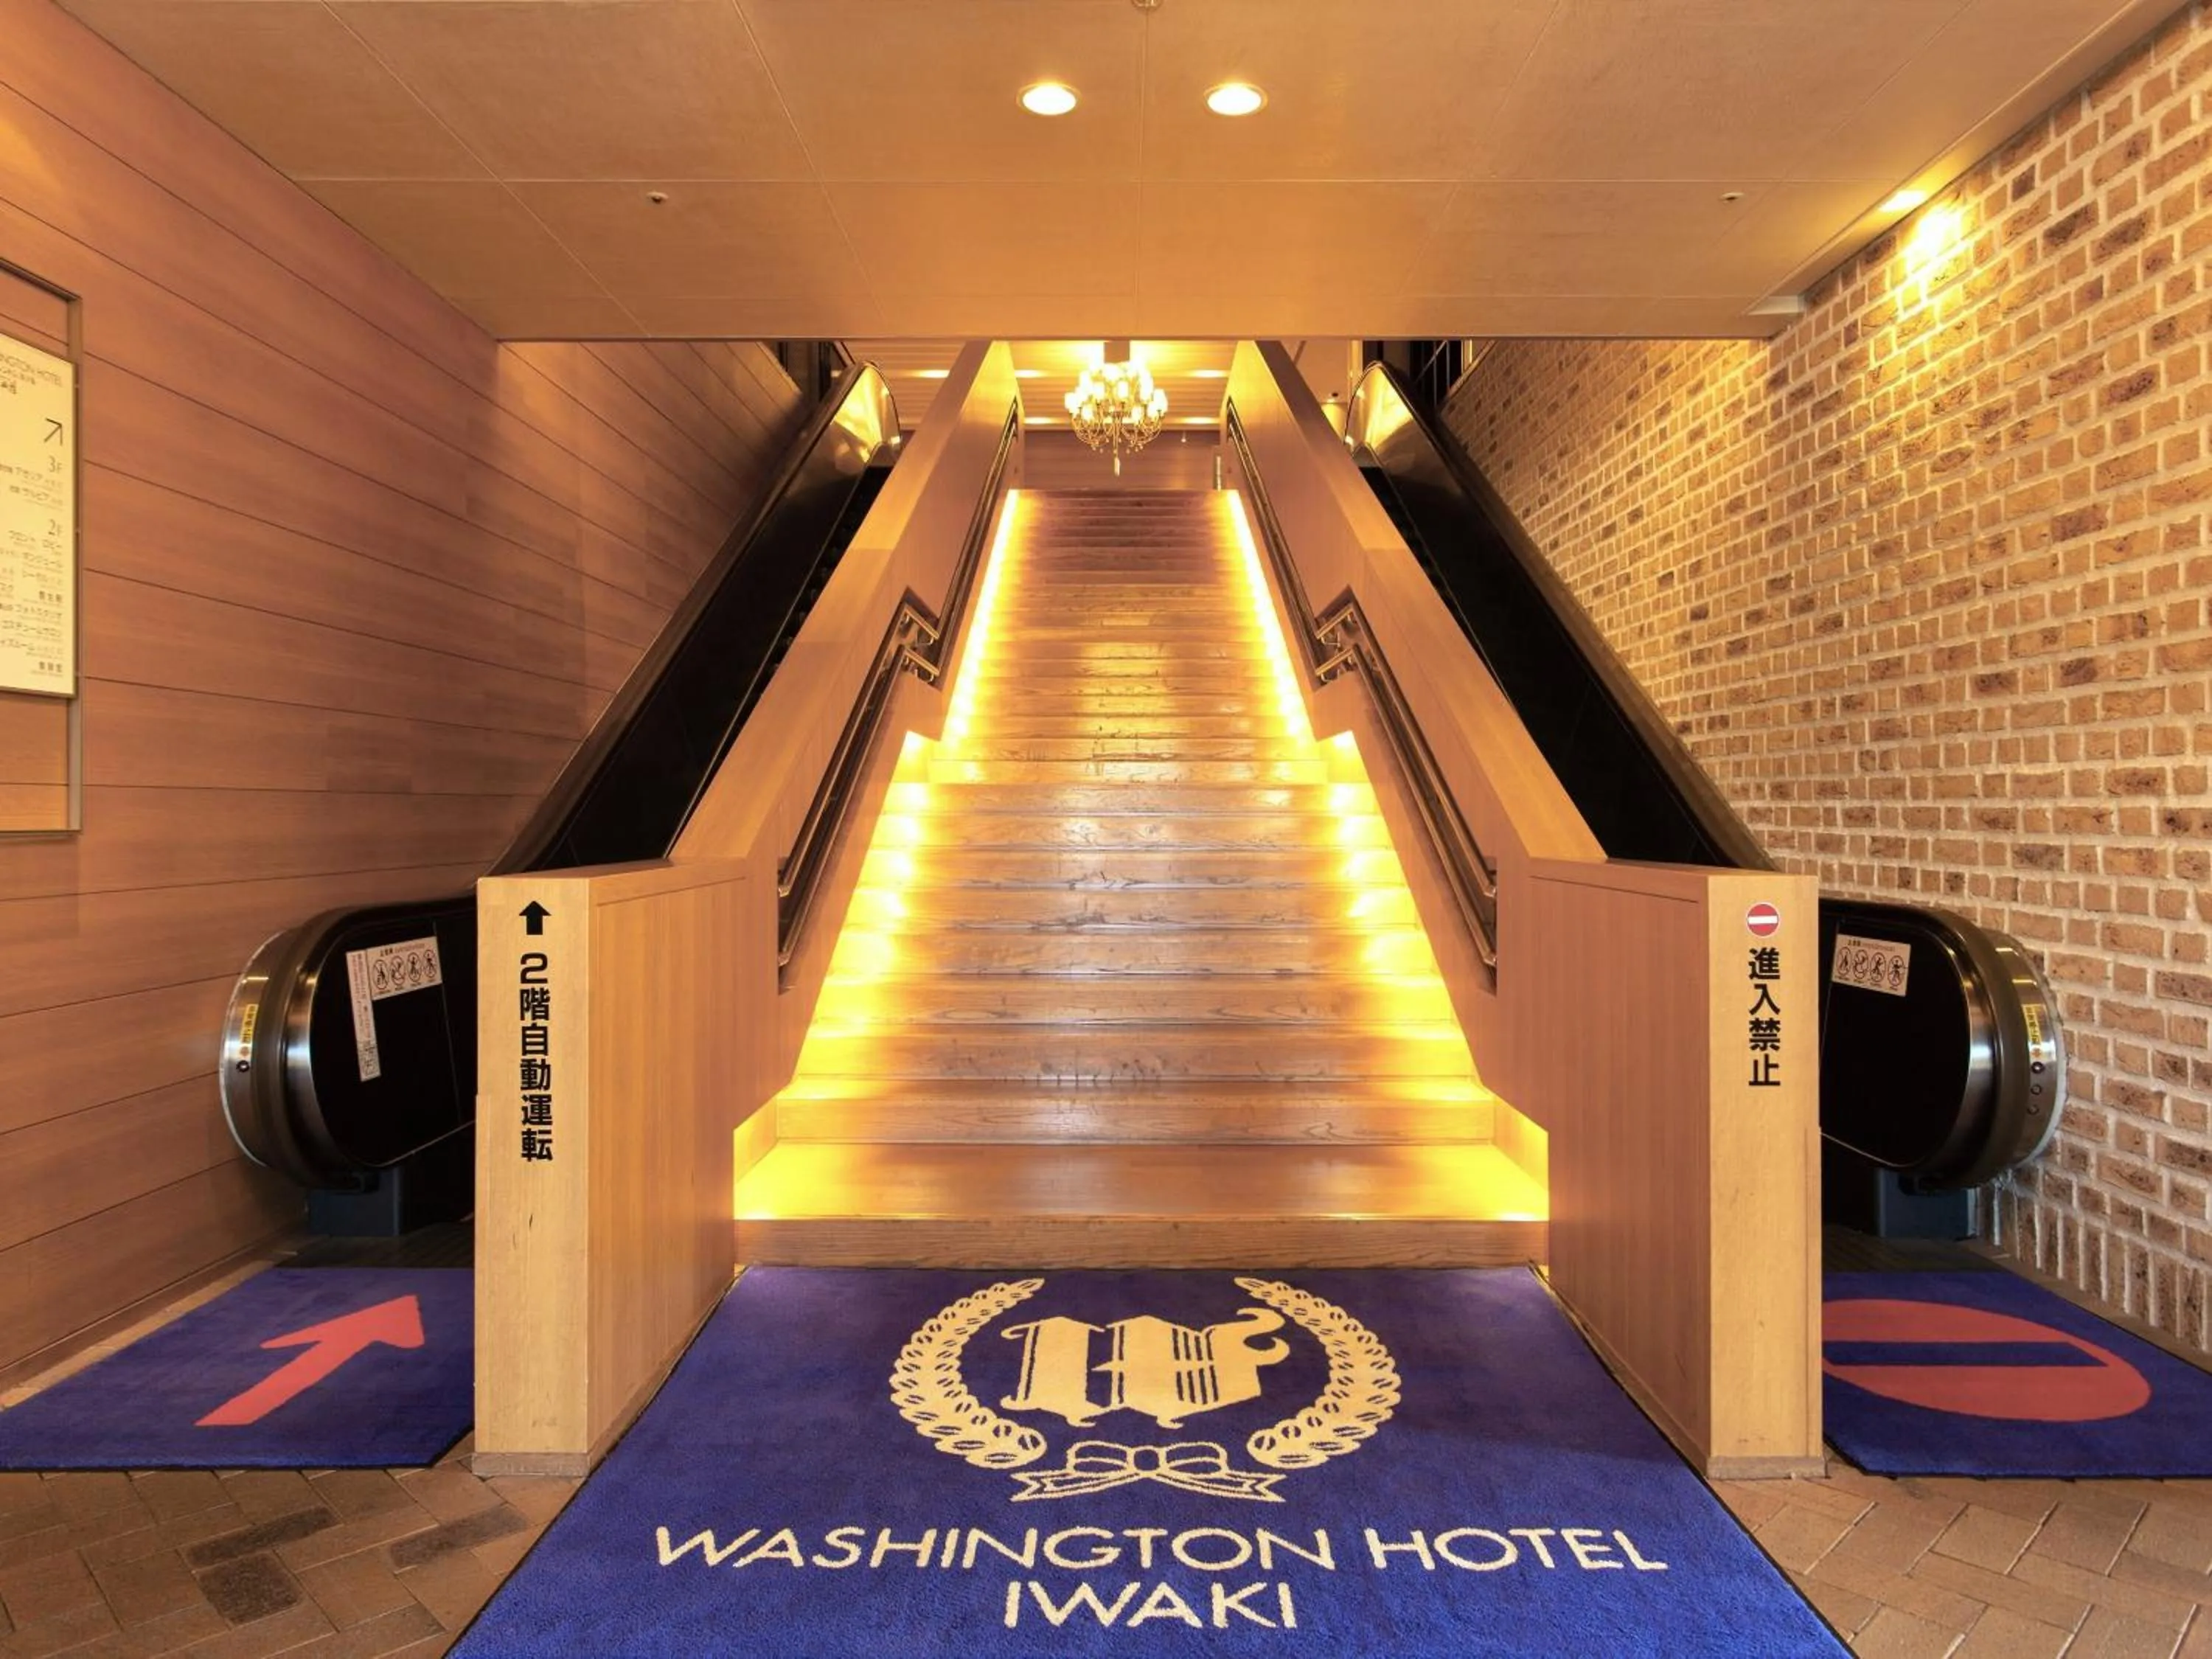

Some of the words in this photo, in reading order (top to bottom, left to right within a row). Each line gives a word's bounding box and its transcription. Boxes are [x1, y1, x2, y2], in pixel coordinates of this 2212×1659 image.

[49, 455, 63, 473] 3F
[48, 518, 63, 537] 2F
[1748, 947, 1781, 1087] 進入禁止
[520, 953, 553, 1162] 2階自動運転
[655, 1526, 1335, 1572] WASHINGTON
[1364, 1527, 1667, 1573] HOTEL
[1004, 1581, 1296, 1630] IWAKI
